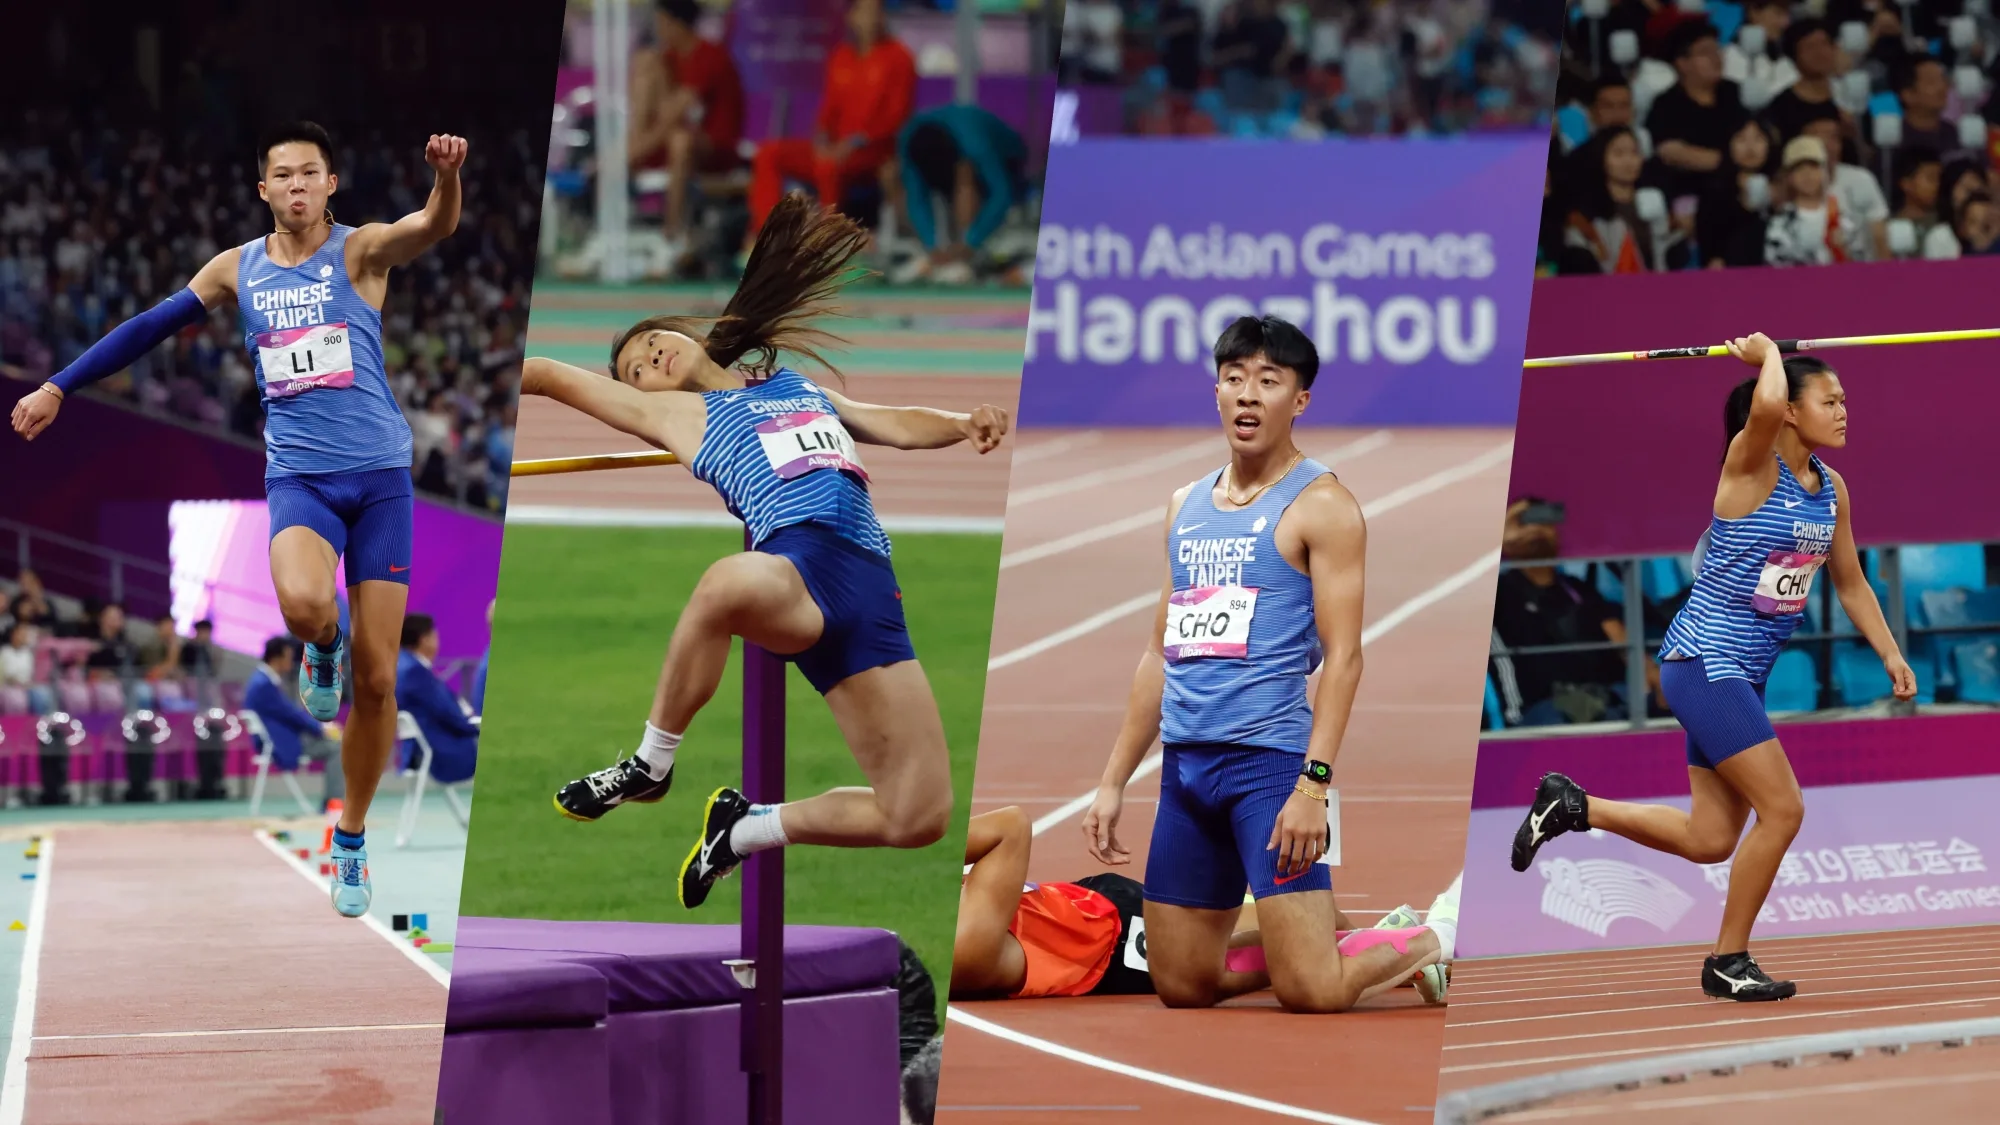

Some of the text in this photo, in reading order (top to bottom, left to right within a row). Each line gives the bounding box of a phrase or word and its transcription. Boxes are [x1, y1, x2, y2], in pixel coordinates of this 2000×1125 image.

[1139, 223, 1295, 279] Asian
[1300, 223, 1495, 279] Games
[253, 281, 333, 311] CHINESE
[264, 303, 325, 330] TAIPEI
[323, 334, 342, 346] 900
[291, 350, 314, 373] LI
[795, 431, 844, 454] LIN
[1792, 520, 1836, 541] CHINES
[1178, 537, 1257, 563] CHINESE
[1187, 563, 1242, 588] TAIPEI
[1776, 573, 1810, 596] CHU
[1229, 600, 1247, 611] 894
[1179, 612, 1230, 638] CHO
[1777, 893, 1841, 922] 19th
[1844, 888, 1918, 918] Asian
[1914, 884, 2000, 911] Games
